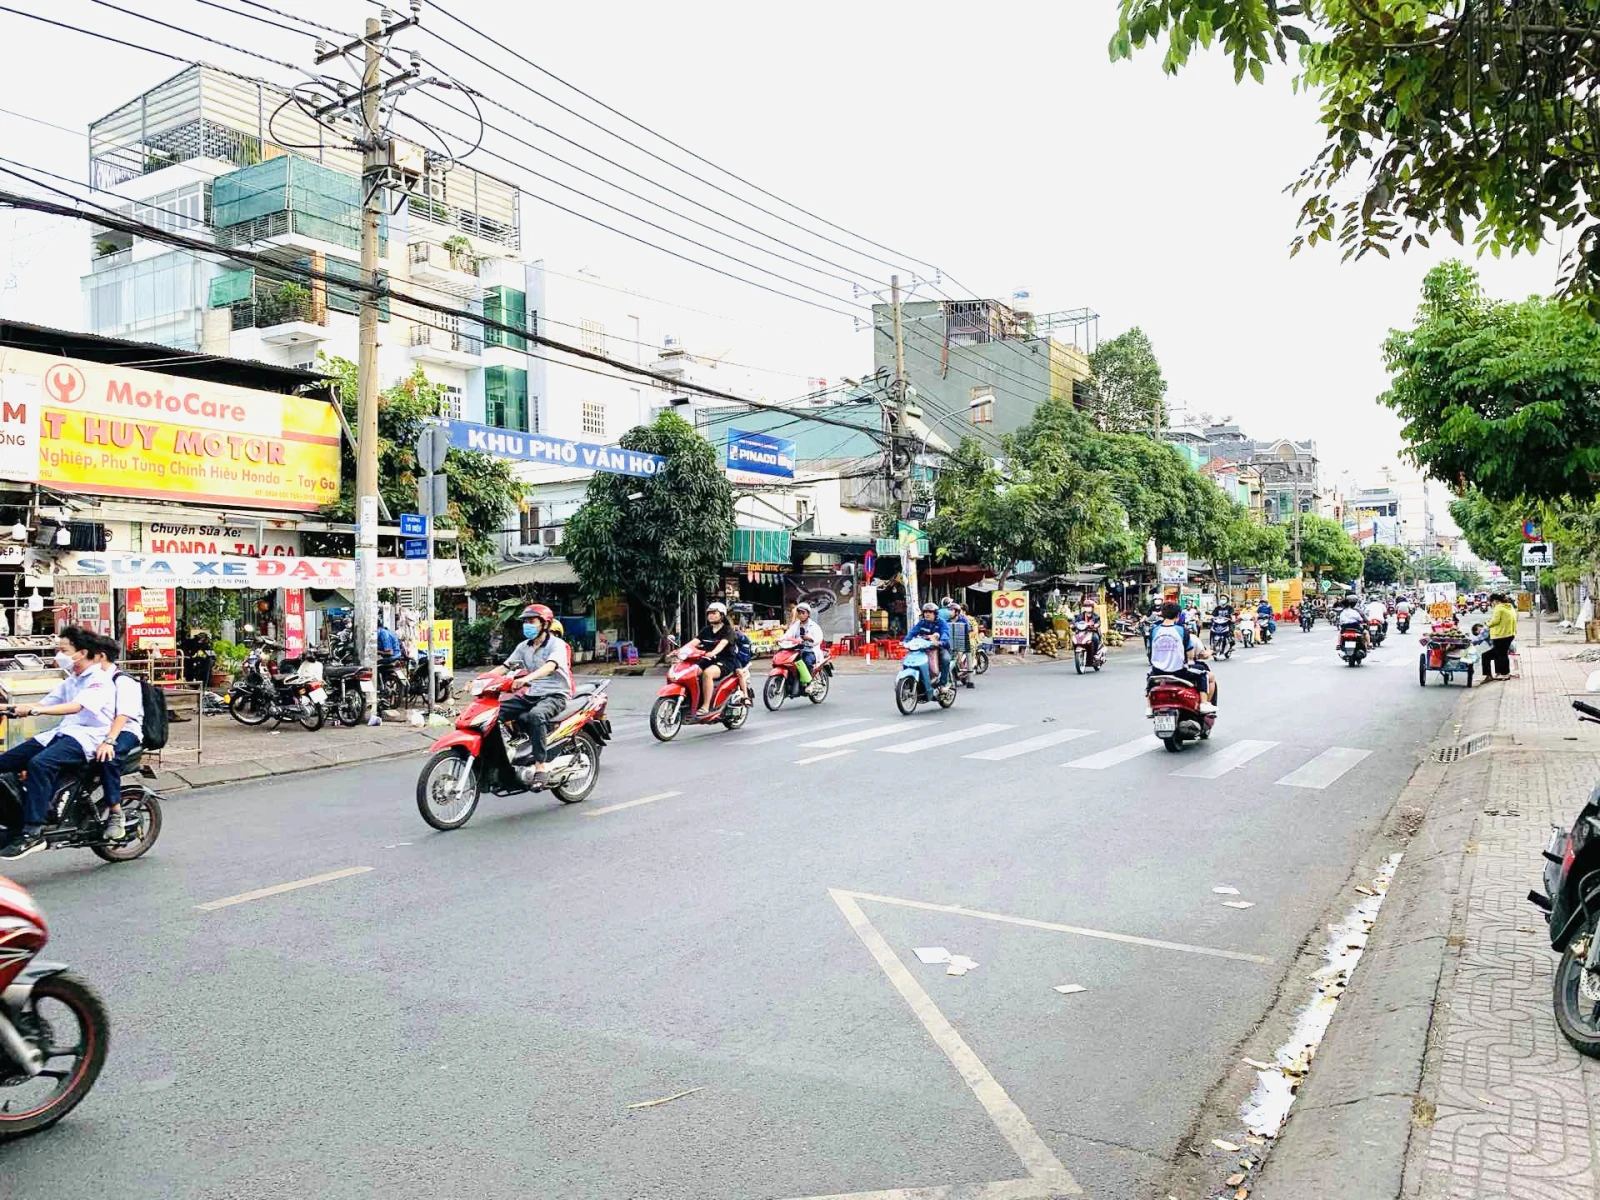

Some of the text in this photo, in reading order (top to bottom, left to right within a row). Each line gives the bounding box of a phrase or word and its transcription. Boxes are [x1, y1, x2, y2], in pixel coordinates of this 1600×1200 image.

[106, 380, 246, 421] MotoCare
[84, 417, 159, 450] HUY
[173, 430, 287, 466] MOTOR
[468, 429, 523, 455] KHU
[529, 439, 577, 464] PHỐ
[582, 448, 626, 471] VĂN
[242, 469, 280, 485] Honda
[299, 474, 317, 491] Tay
[320, 477, 335, 491] Ga
[199, 524, 221, 537] Sửa
[152, 539, 217, 554] HONDA
[76, 554, 175, 576] SỬA
[191, 561, 248, 576] XE
[255, 559, 347, 581] ĐẠT
[995, 592, 1025, 608] ỐC
[996, 610, 1024, 618] 244
[131, 627, 171, 636] HONDA
[439, 628, 450, 641] XE
